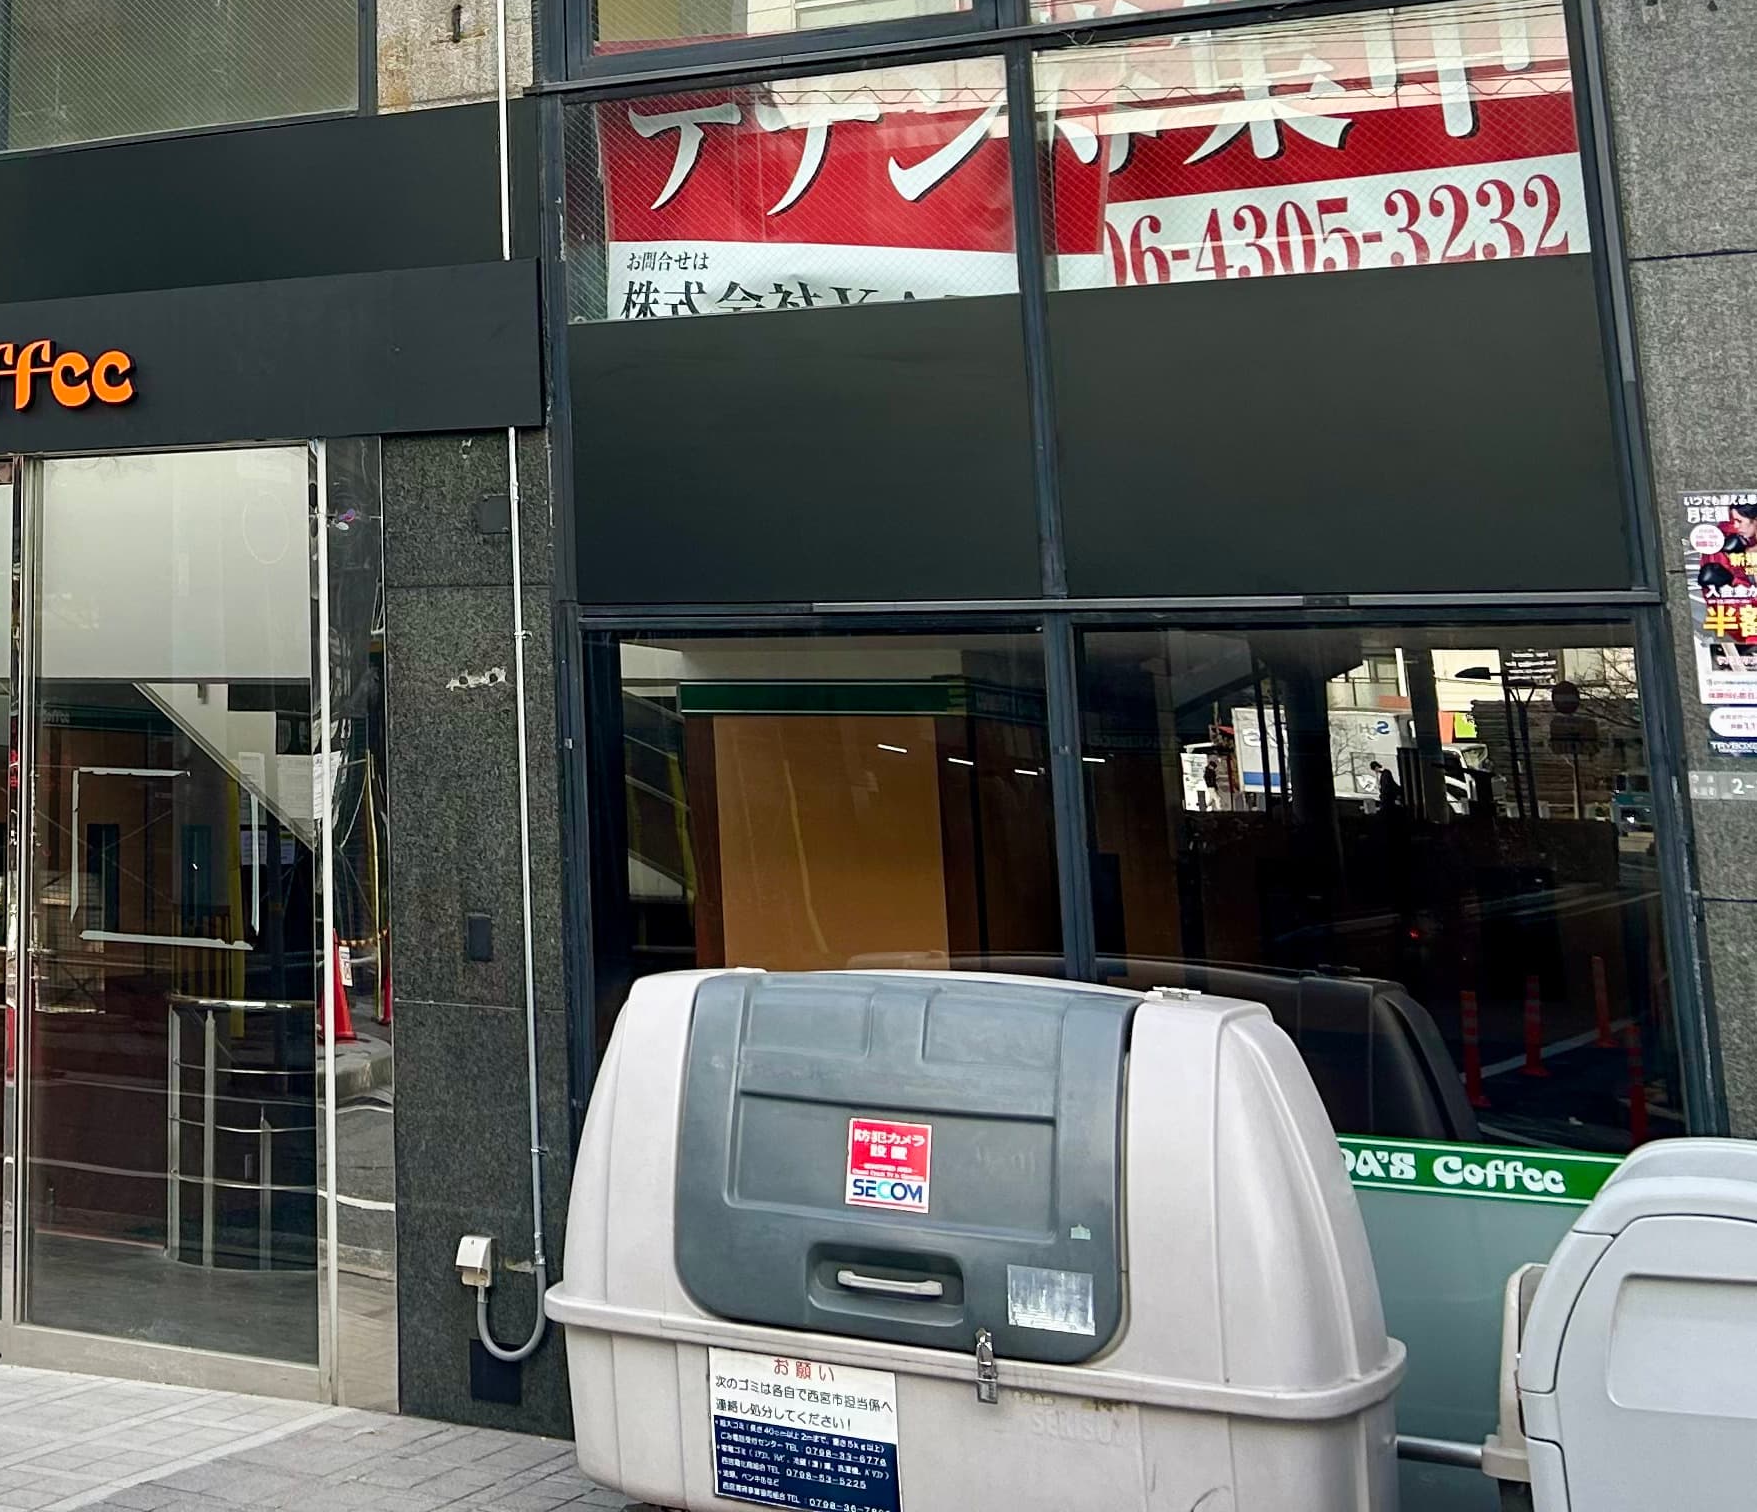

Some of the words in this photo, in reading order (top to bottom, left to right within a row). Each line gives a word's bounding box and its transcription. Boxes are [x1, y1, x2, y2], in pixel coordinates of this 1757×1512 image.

[626, 252, 709, 272] お問合せは
[854, 1128, 926, 1147] 防犯カメラ
[1432, 1155, 1567, 1194] Coffee
[852, 1178, 923, 1203] SECOM
[774, 1358, 835, 1382] お願い
